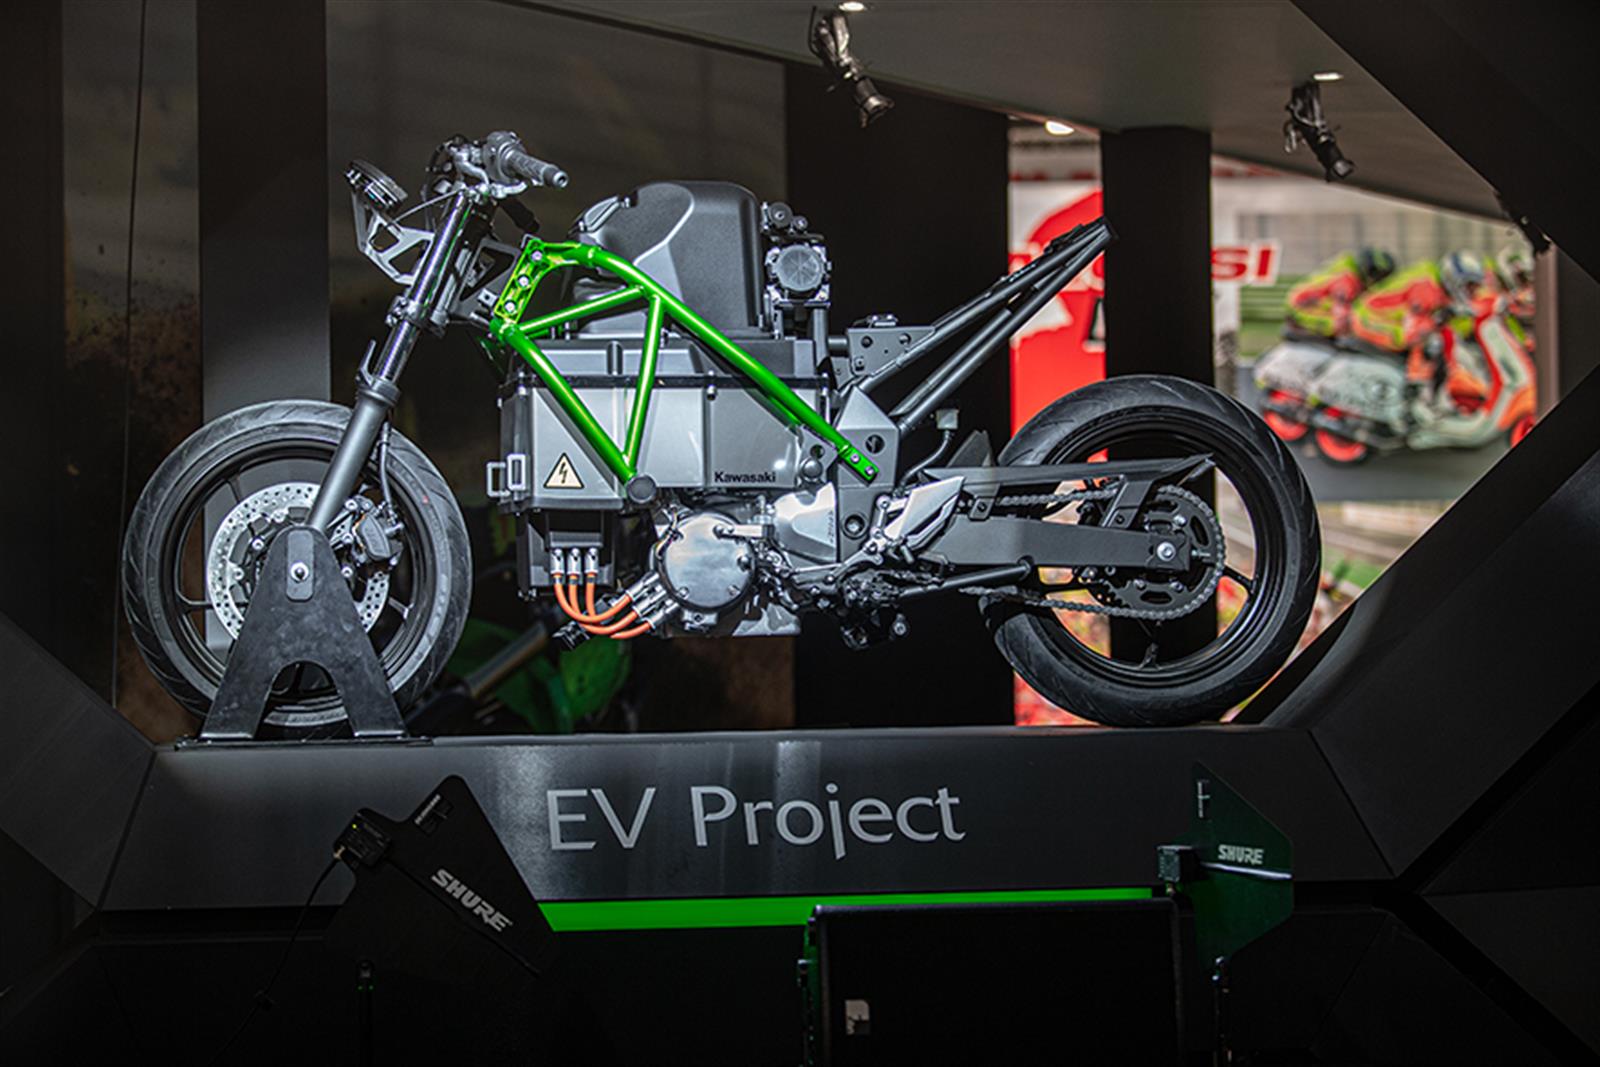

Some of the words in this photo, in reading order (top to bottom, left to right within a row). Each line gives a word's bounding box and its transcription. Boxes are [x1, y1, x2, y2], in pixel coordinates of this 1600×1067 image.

[714, 471, 776, 483] Kawasaki
[546, 787, 656, 851] EV
[690, 783, 967, 860] Project
[1217, 844, 1264, 865] SHURE
[430, 868, 514, 933] SHURE
